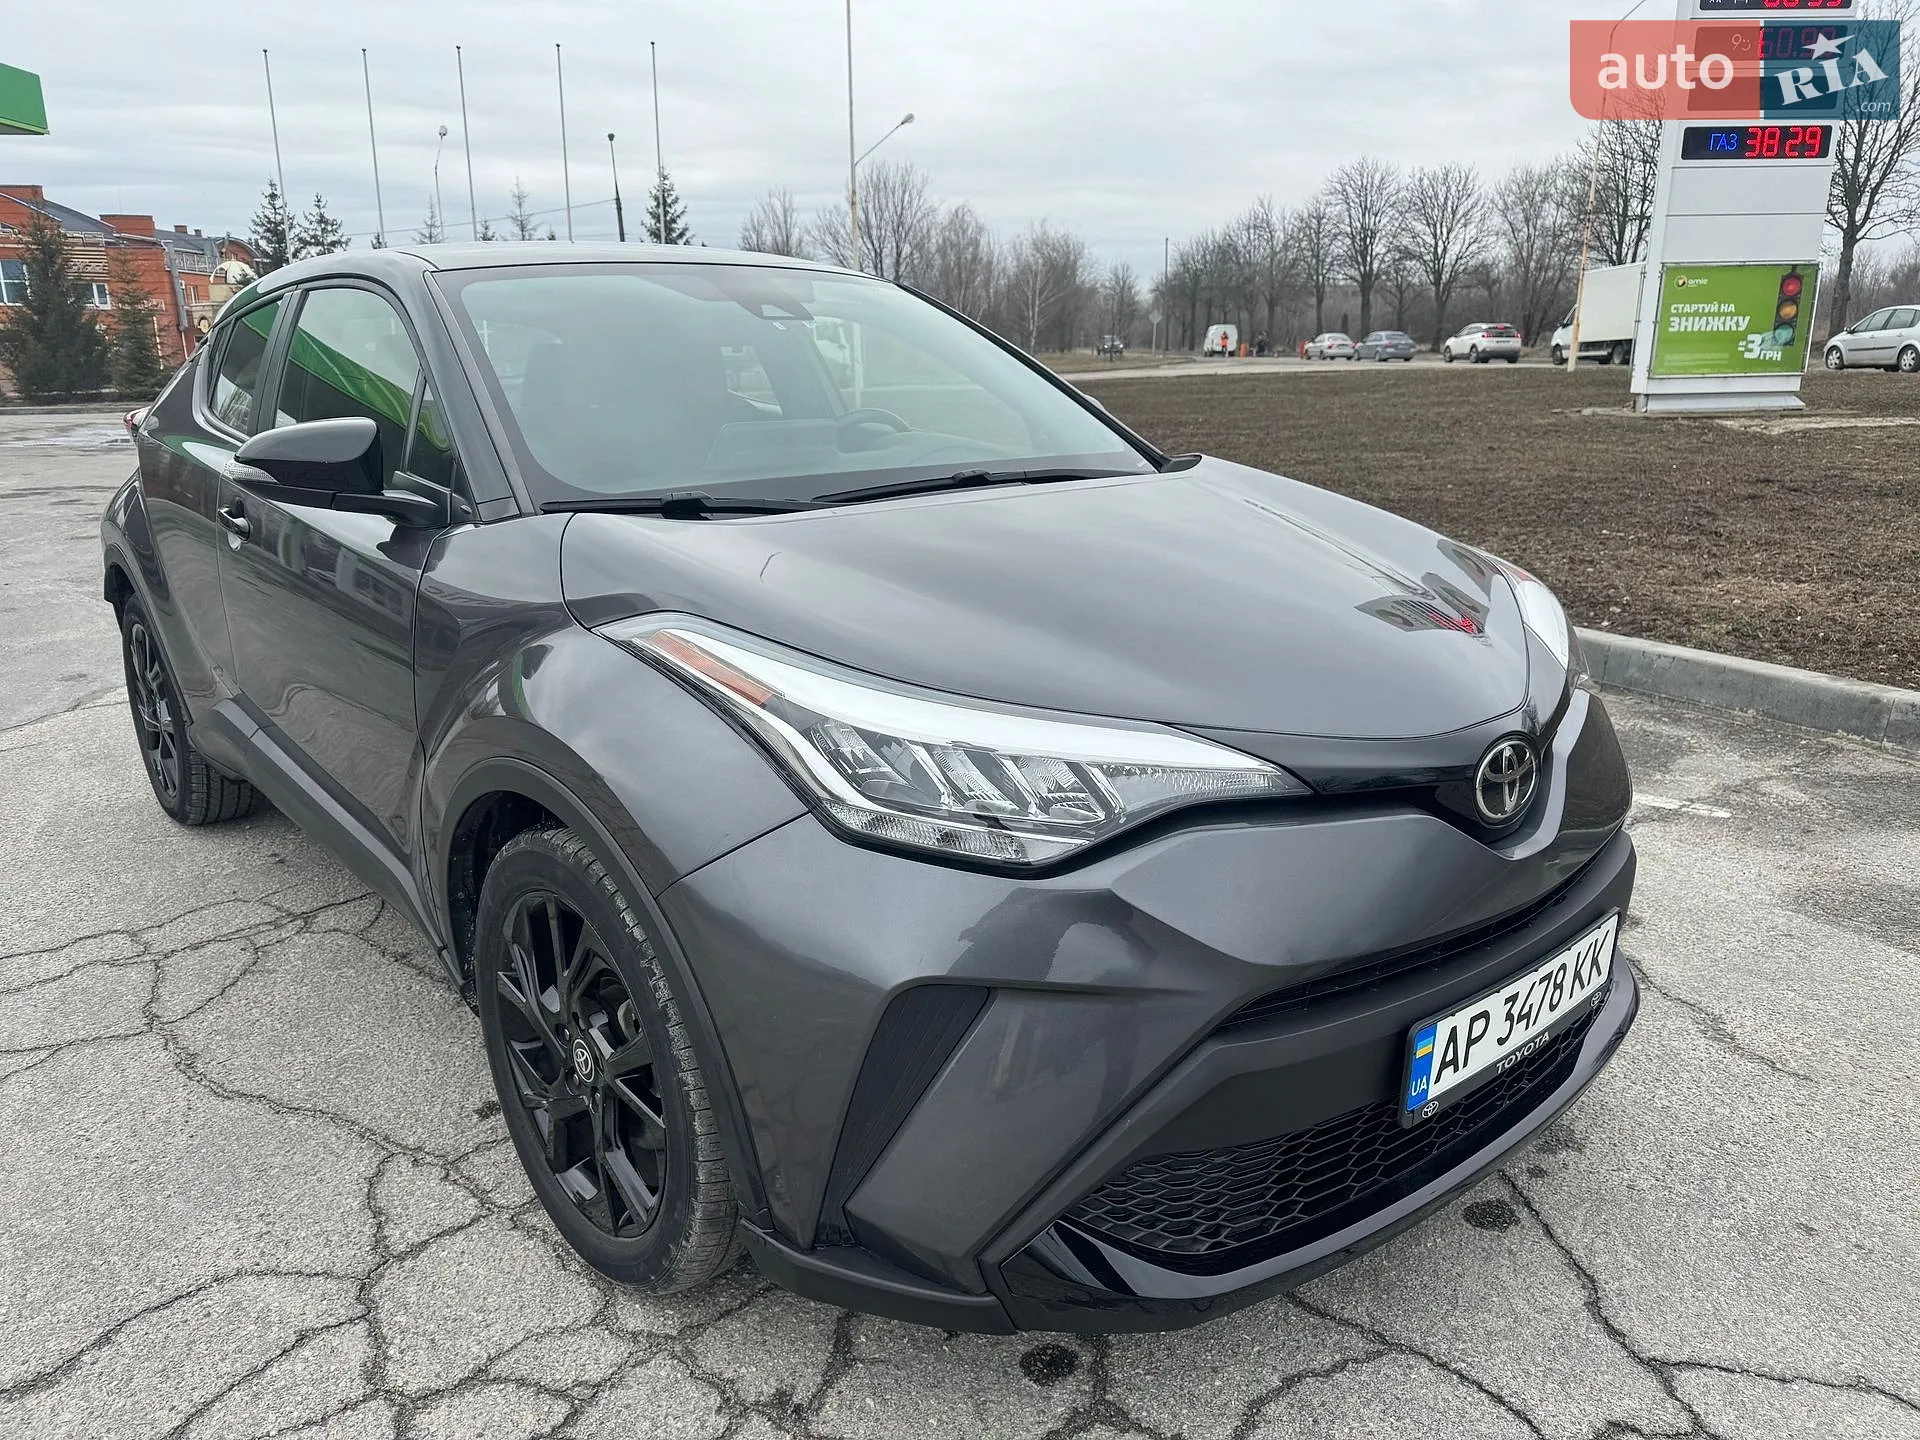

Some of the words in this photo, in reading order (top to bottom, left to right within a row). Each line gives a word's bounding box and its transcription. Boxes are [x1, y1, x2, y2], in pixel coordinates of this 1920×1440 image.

[1709, 133, 1738, 151] ГАЗ
[1671, 302, 1718, 313] СТАРТУЙ
[1720, 303, 1735, 312] НА
[1668, 316, 1750, 332] ЗНИЖКУ
[1760, 350, 1782, 361] ГРН
[1434, 1009, 1491, 1085] AP
[1497, 962, 1567, 1046] 3478
[1569, 929, 1610, 1000] KK
[1496, 1031, 1550, 1074] TOYOTA
[1410, 1076, 1428, 1097] UA
